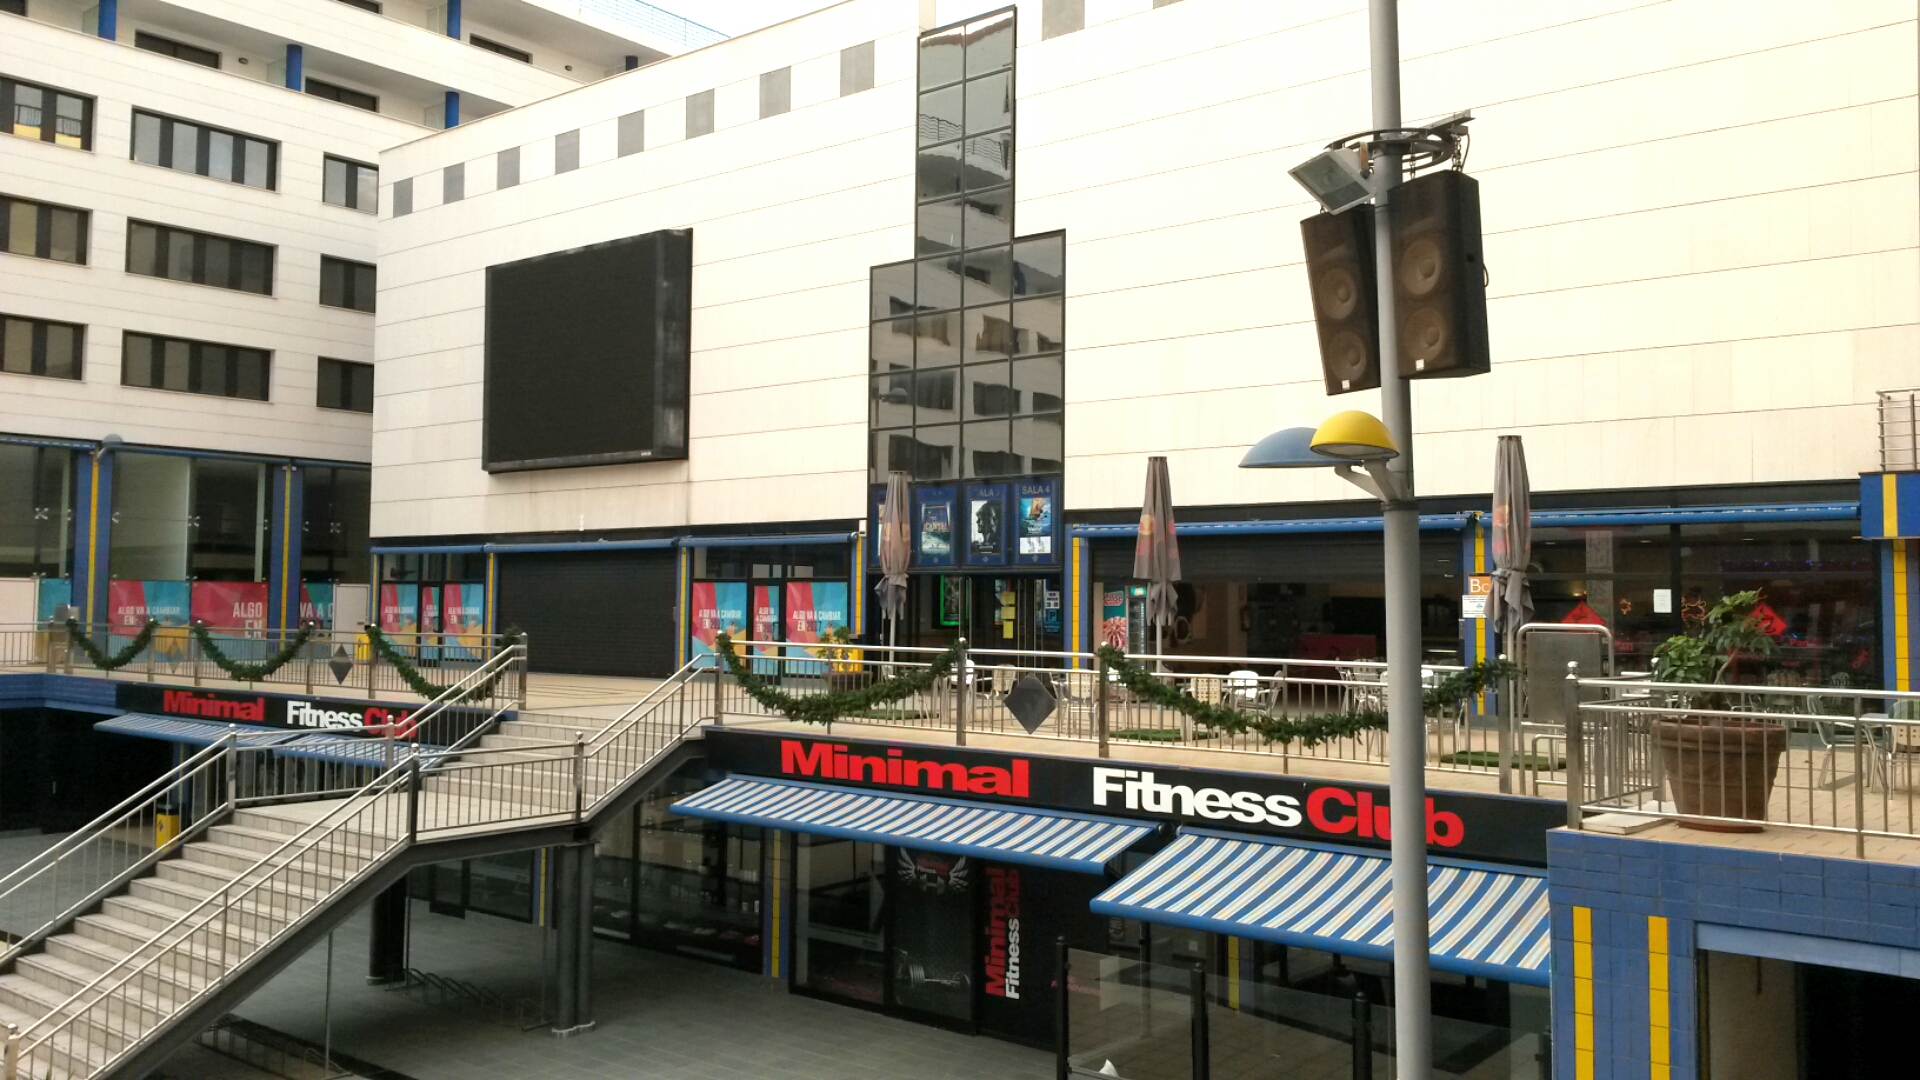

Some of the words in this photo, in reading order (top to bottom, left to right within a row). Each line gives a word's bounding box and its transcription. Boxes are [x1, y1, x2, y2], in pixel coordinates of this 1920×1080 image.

[1022, 485, 1043, 495] SALA
[1045, 485, 1050, 494] 4
[233, 602, 263, 618] ALGO
[299, 603, 313, 618] VA
[317, 604, 325, 618] A
[163, 689, 265, 722] Minimal
[287, 700, 363, 732] Fitness
[780, 739, 1029, 798] Minimal
[1092, 766, 1303, 828] Fitness
[984, 866, 1006, 998] Minimal
[1005, 918, 1020, 1000] Fitness
